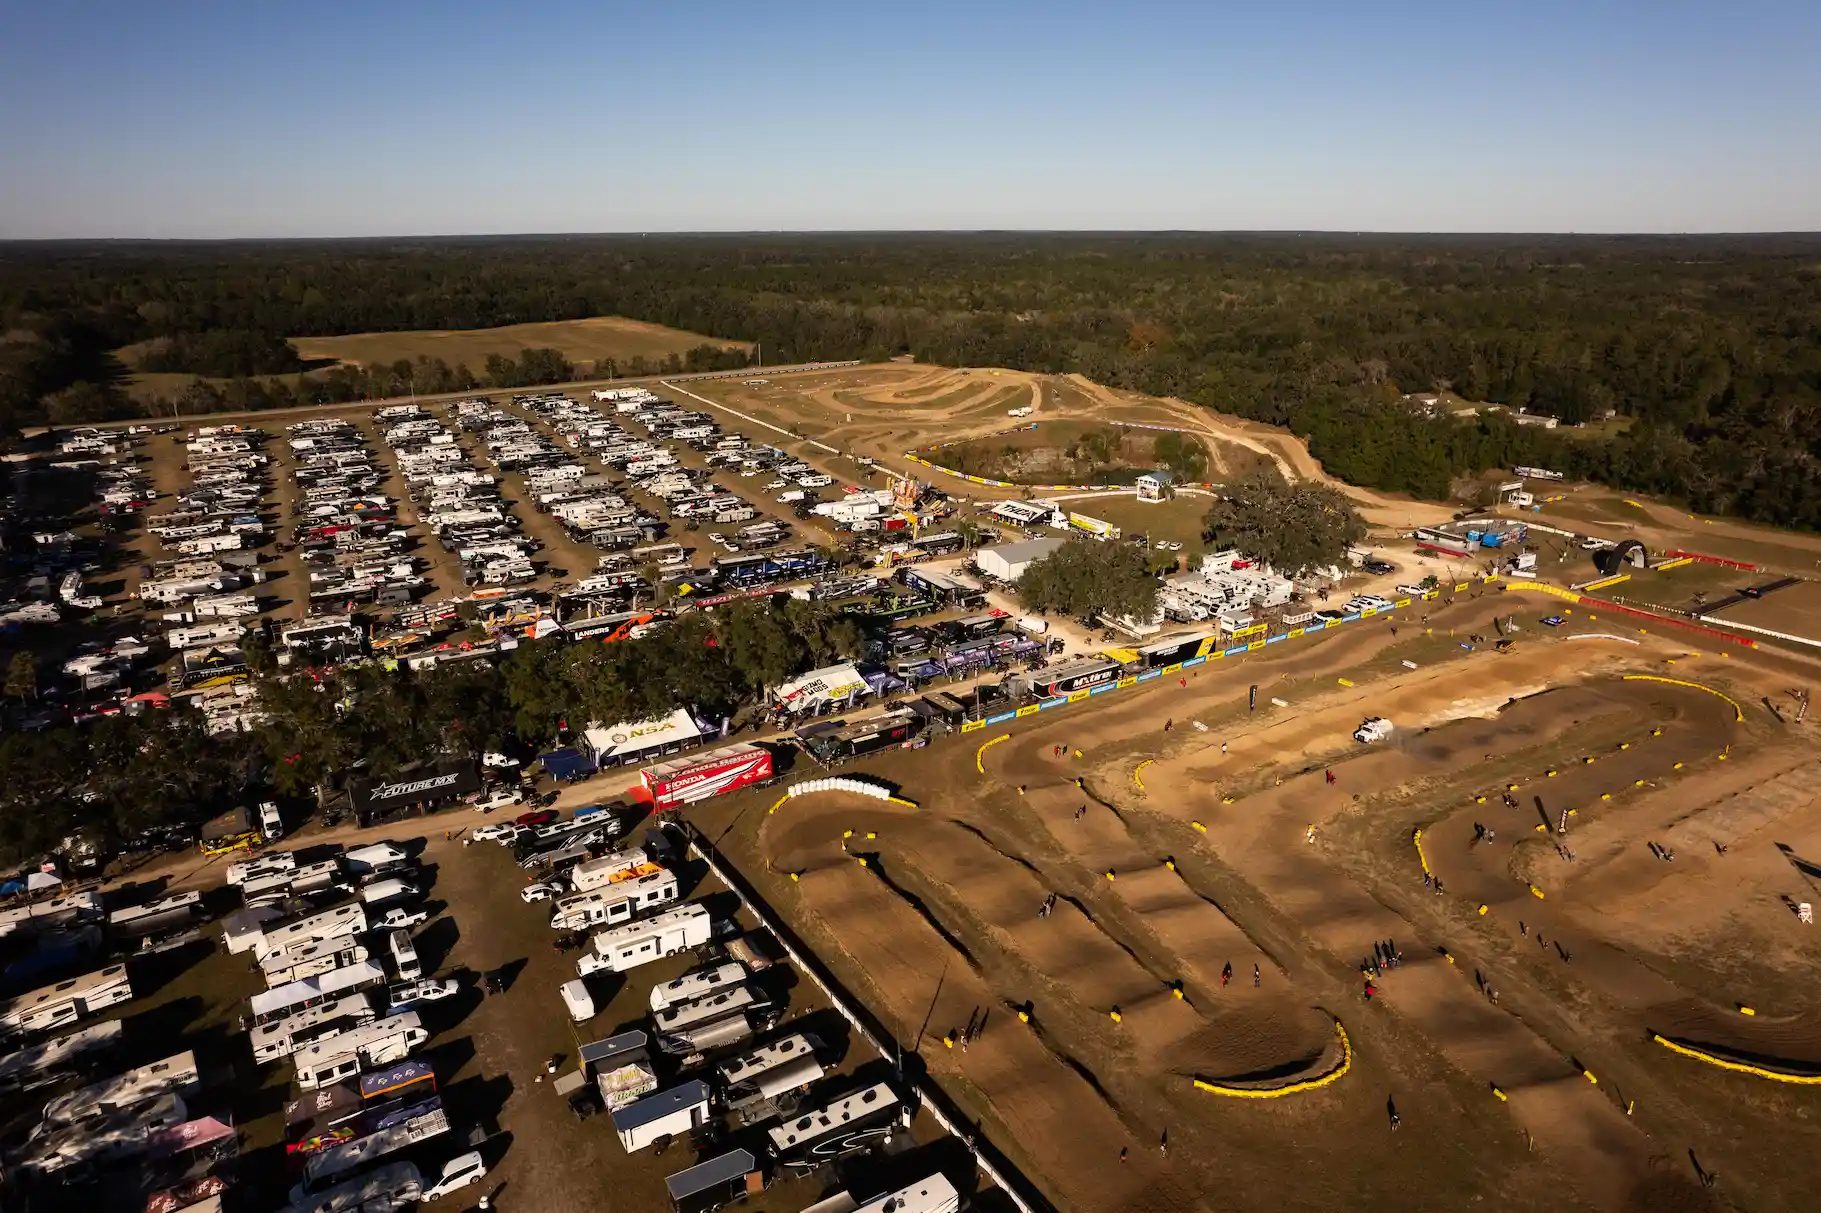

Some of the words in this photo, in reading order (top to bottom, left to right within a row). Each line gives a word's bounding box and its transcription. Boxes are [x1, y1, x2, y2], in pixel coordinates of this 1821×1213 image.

[575, 627, 610, 640] LANDERS
[803, 679, 823, 691] GIZMO
[807, 684, 829, 696] MODS
[629, 723, 675, 738] NSA
[384, 781, 432, 797] FUTURE
[435, 775, 457, 786] MX
[665, 774, 706, 790] HONDA
